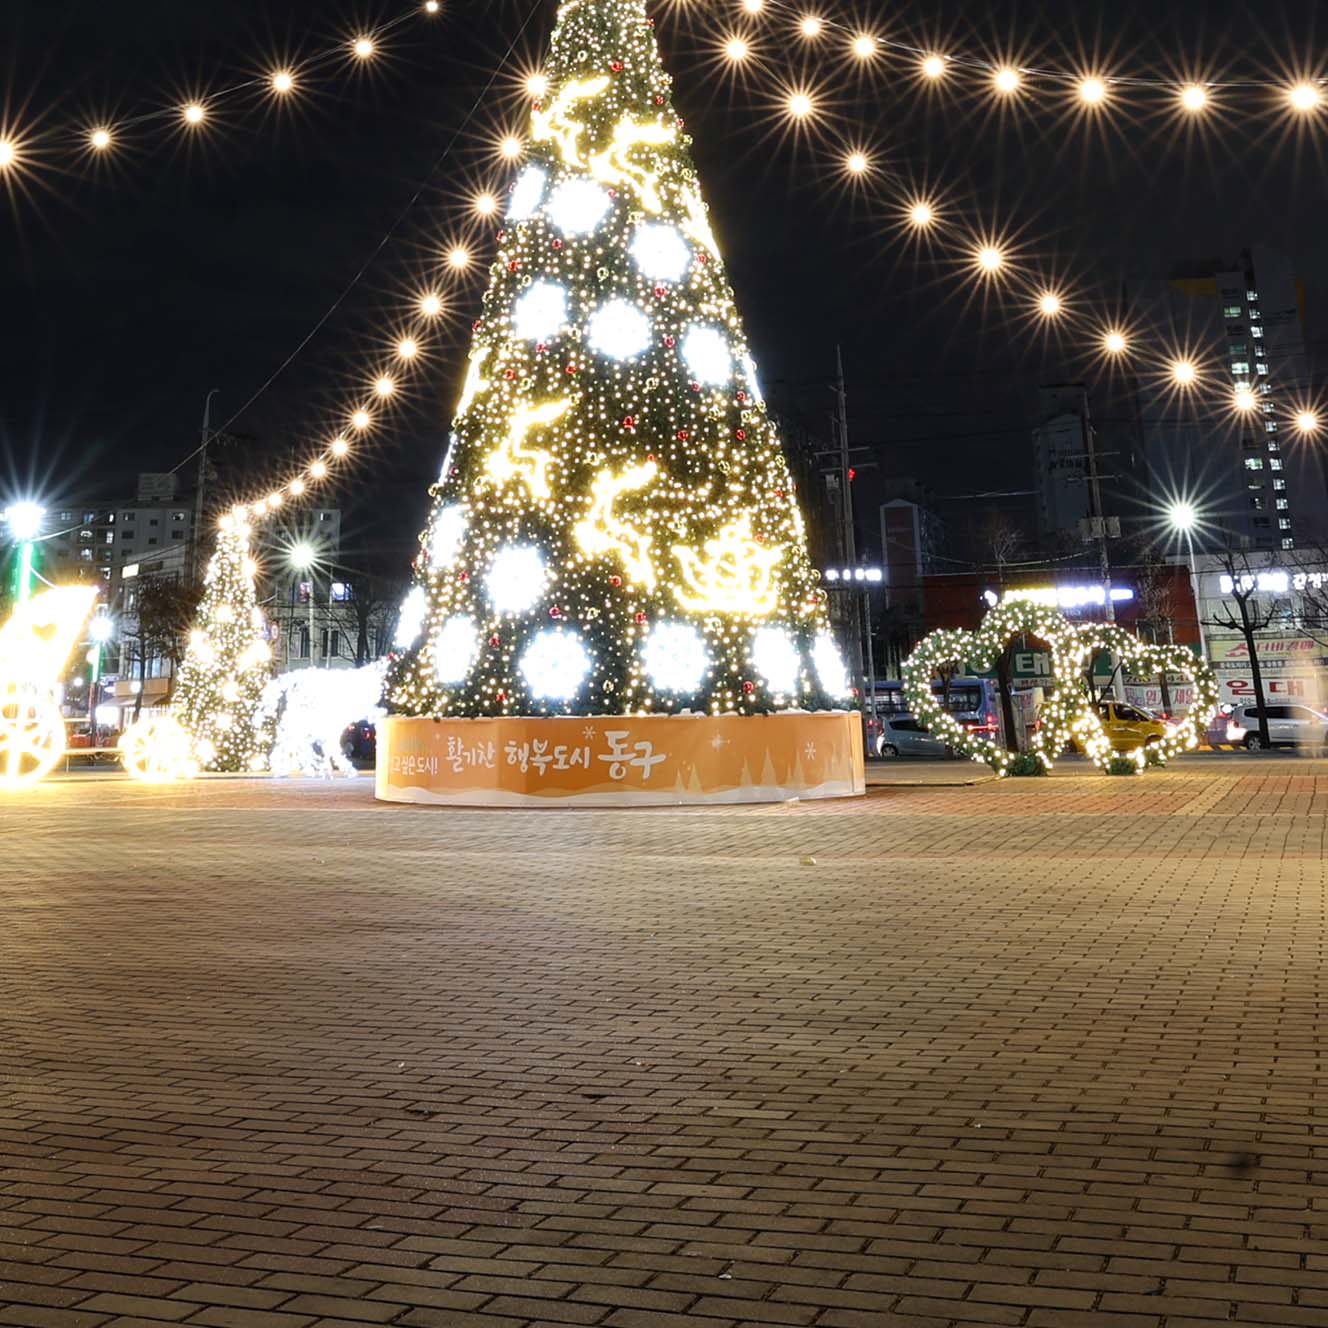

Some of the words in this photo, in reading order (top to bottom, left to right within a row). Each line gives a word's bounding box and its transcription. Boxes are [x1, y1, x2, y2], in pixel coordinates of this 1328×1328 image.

[446, 735, 497, 773] 활기찬
[504, 738, 591, 777] 행복도시
[598, 730, 667, 780] 동구
